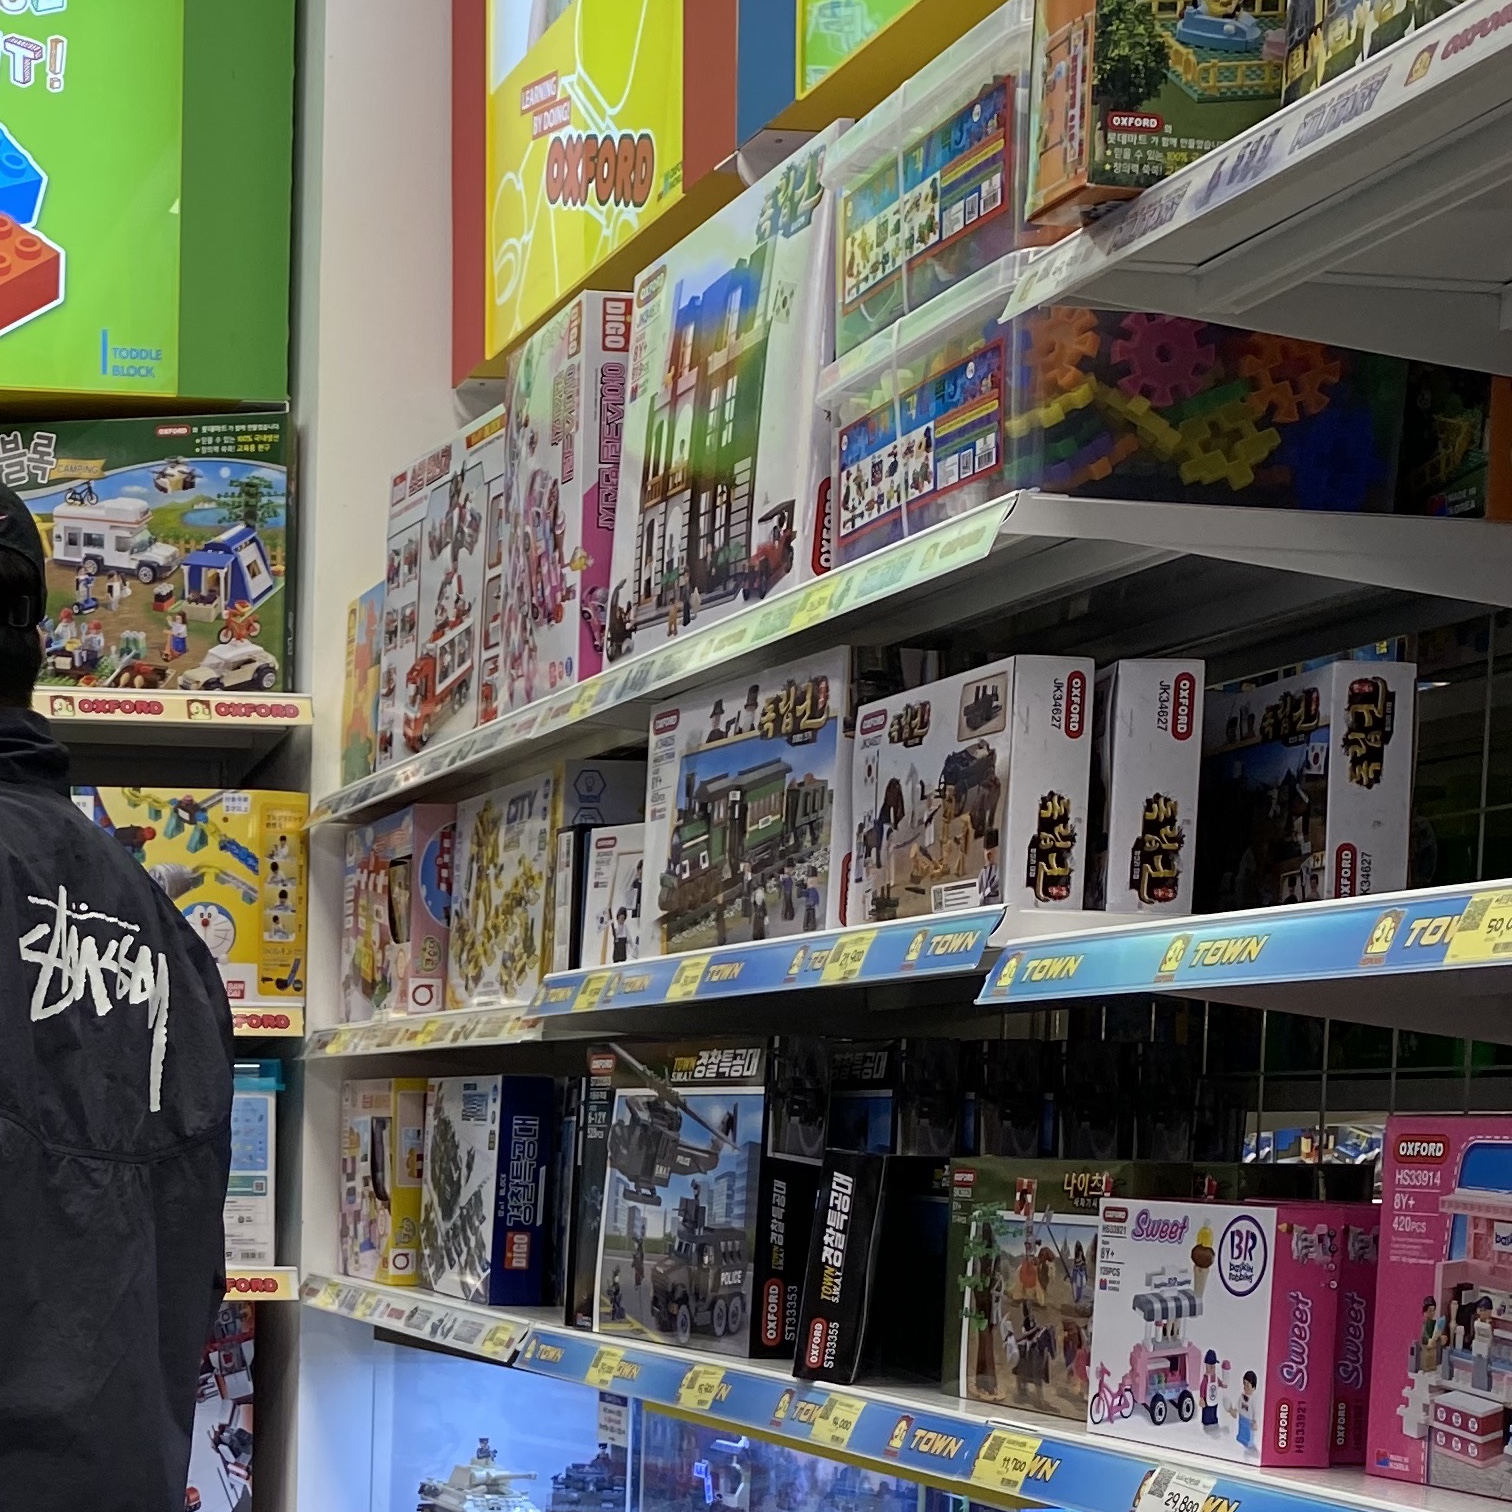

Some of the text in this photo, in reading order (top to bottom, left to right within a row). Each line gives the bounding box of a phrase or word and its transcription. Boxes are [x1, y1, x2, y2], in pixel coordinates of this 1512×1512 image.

[521, 75, 558, 111] LEARNING
[1112, 117, 1158, 128] OXFORD
[545, 133, 655, 208] OXFORD
[112, 347, 162, 361] TODDLE
[112, 364, 155, 378] BLOCK
[599, 363, 626, 464] 아이스크림
[57, 464, 99, 476] CAMPING
[78, 700, 164, 714] OXFORD
[215, 703, 300, 719] OXFORD
[1051, 678, 1064, 731] JK34627
[1070, 678, 1081, 732] OXFORD
[1157, 680, 1171, 732] JK34627
[1177, 679, 1190, 733] OXFORD
[928, 931, 982, 955] TOWN
[1188, 934, 1269, 968] TOWN
[1020, 955, 1084, 982] TOWN
[694, 1048, 761, 1079] 경찰특공대
[1398, 1142, 1445, 1158] OXFORD
[1395, 1169, 1441, 1186] HS33914
[1393, 1193, 1416, 1210] 8Y+
[822, 1171, 854, 1267] 경찰특공대
[1131, 1208, 1189, 1243] Sweet
[1230, 1230, 1257, 1262] BR
[720, 1271, 742, 1286] POLICE
[766, 1284, 779, 1340] OXFORD
[784, 1285, 798, 1341] ST33353
[810, 1321, 824, 1364] OXFORD
[823, 1321, 840, 1369] ST33355
[1280, 1289, 1313, 1392] Sweet
[1277, 1403, 1290, 1449] OXFORD
[909, 1428, 963, 1459] TOWN
